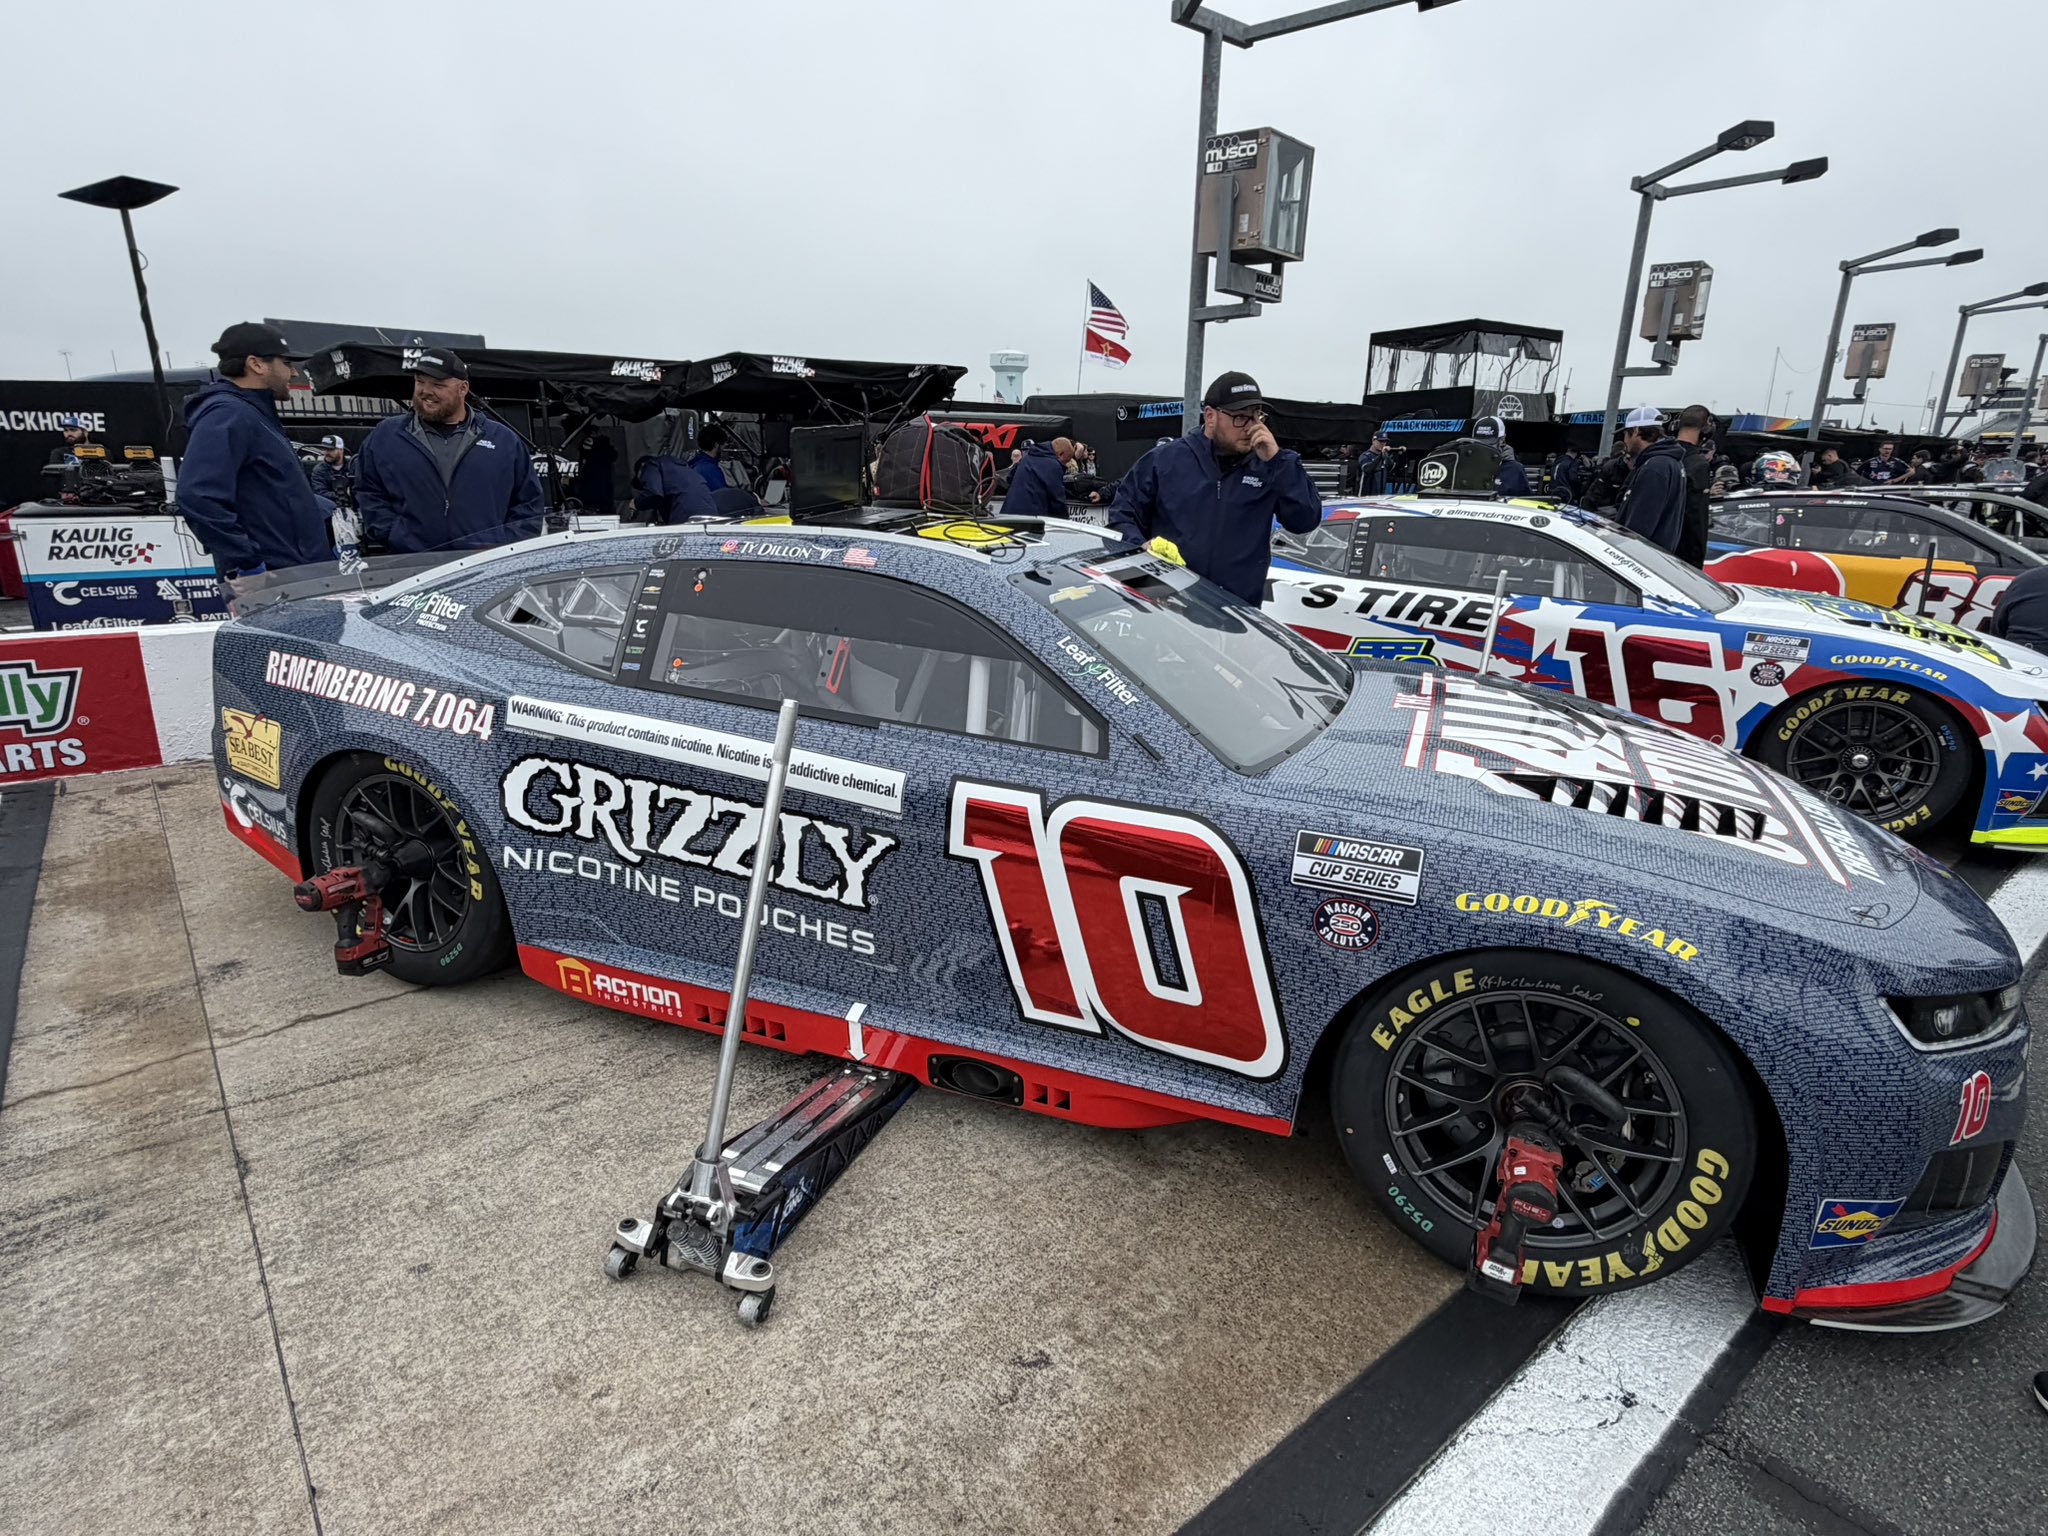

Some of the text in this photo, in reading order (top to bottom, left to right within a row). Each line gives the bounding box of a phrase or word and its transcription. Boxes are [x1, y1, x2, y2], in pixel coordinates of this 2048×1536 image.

[0, 411, 106, 432] ACKHOSE
[1391, 420, 1453, 431] TRACKHOUSE
[51, 527, 134, 544] KAULIG
[757, 542, 813, 559] DILLON
[48, 544, 133, 561] RACING
[1603, 547, 1652, 579] Leaf Filter
[80, 586, 137, 598] CELSIUS
[422, 590, 469, 621] Filter
[1354, 586, 1498, 633] TIRE
[1751, 644, 1800, 656] CUP SERIES
[1766, 635, 1802, 646] NASCAR
[1056, 635, 1140, 706] Leaf Filter
[1830, 653, 1949, 682] GOODYEAR
[265, 650, 497, 742] REMEMBERING 7,064
[1552, 618, 1740, 751] 16
[1777, 685, 1911, 742] GOODYEAR
[0, 737, 88, 774] RTS
[229, 736, 248, 757] SEA
[247, 741, 275, 770] BEST
[511, 699, 898, 799] WARNING: This product contains nicotine. Nicotine is addictive chemical.
[247, 802, 287, 840] CELSIUS
[501, 754, 899, 909] GRIZZLY
[1334, 840, 1404, 866] NASCAR
[503, 846, 681, 902] NICOTINE
[1309, 861, 1402, 889] CUP SERIES
[1323, 902, 1371, 922] NASCAR
[1330, 917, 1362, 930] 250
[1455, 891, 1700, 962] GOODYEAR
[947, 778, 1288, 1080] 10
[1319, 926, 1370, 947] SALUTES
[593, 973, 682, 1010] ACTION
[597, 991, 683, 1019] INDUSTRIES
[1370, 968, 1476, 1051] EAGLE
[1949, 1070, 1991, 1146] 10
[1387, 1186, 1434, 1233] D5290
[1513, 1199, 1547, 1218] FUEL
[1819, 1219, 1886, 1231] SUNOC
